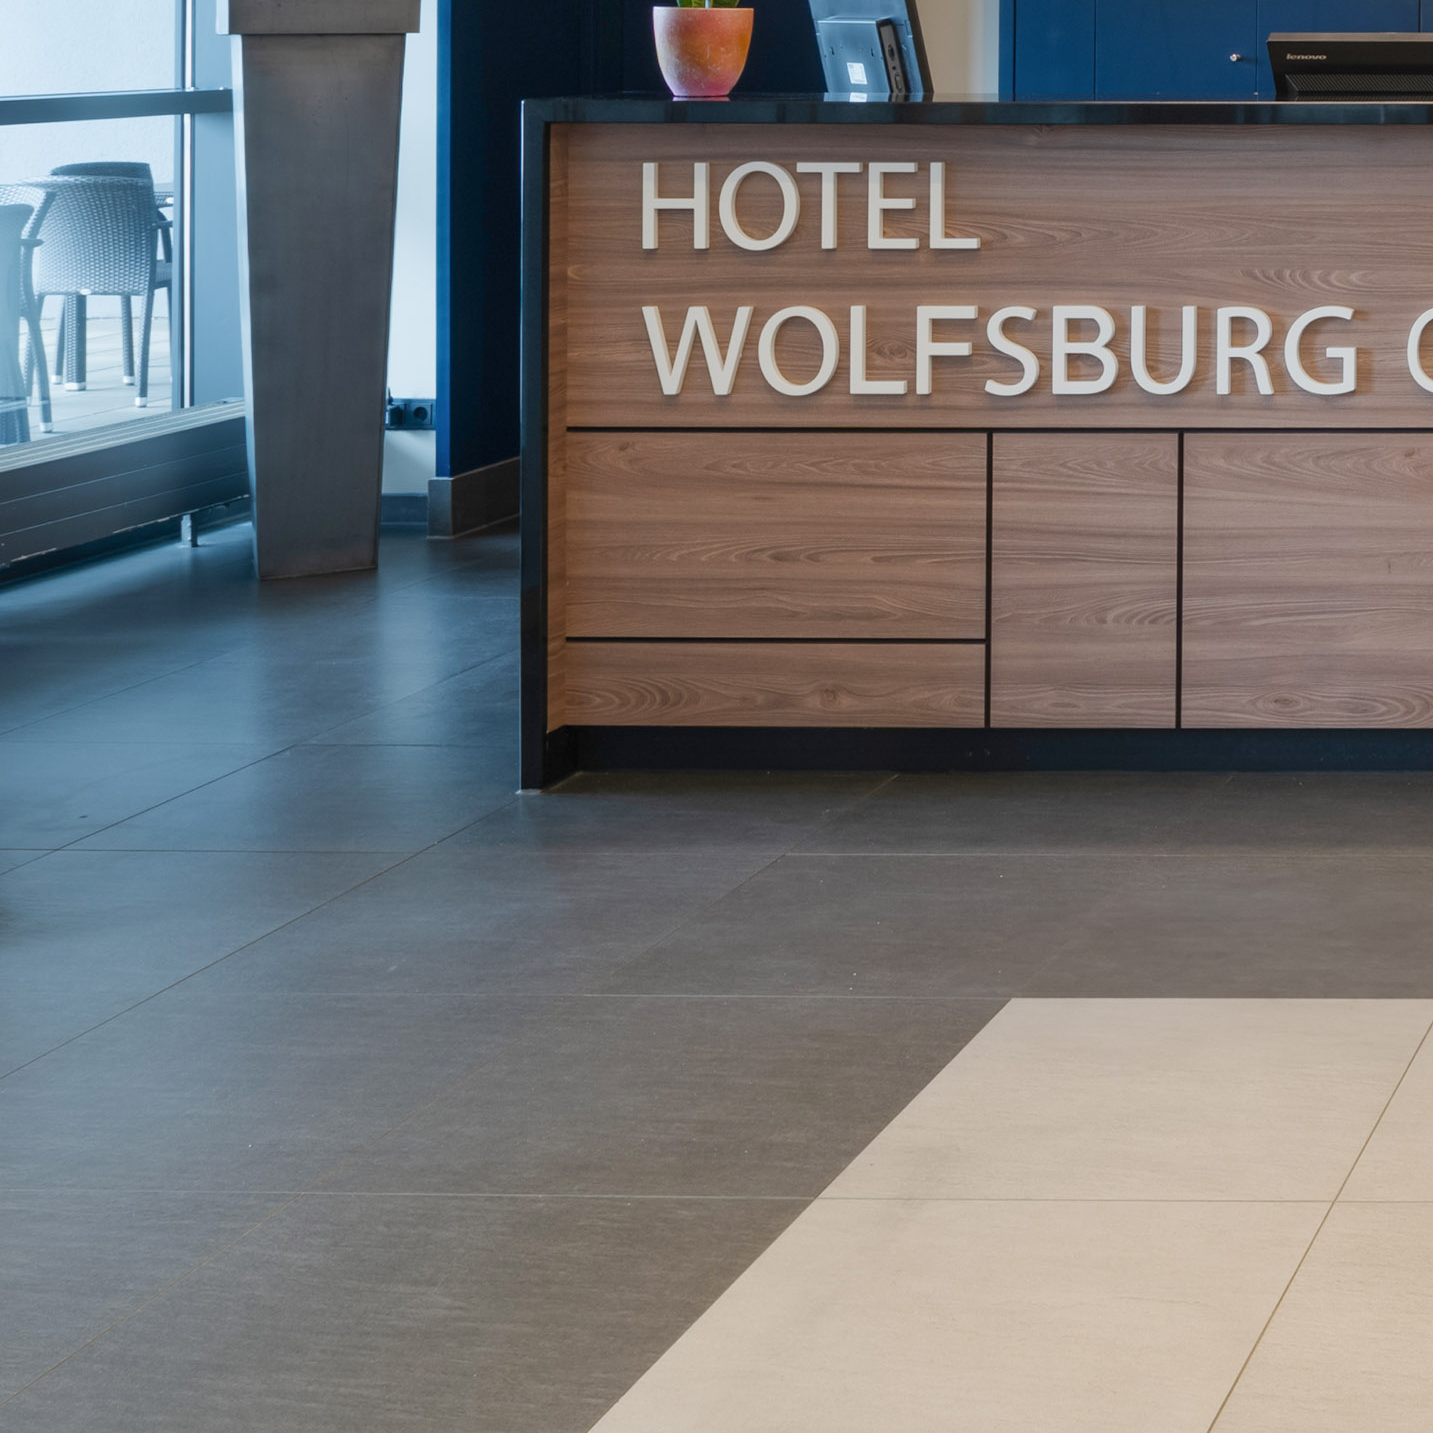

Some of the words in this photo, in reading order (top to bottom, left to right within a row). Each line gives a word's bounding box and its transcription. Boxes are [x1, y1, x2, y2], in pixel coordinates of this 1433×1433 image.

[1286, 53, 1327, 61] lenovo
[642, 161, 981, 251] HOTEL
[641, 305, 1357, 396] WOLFSBURG
